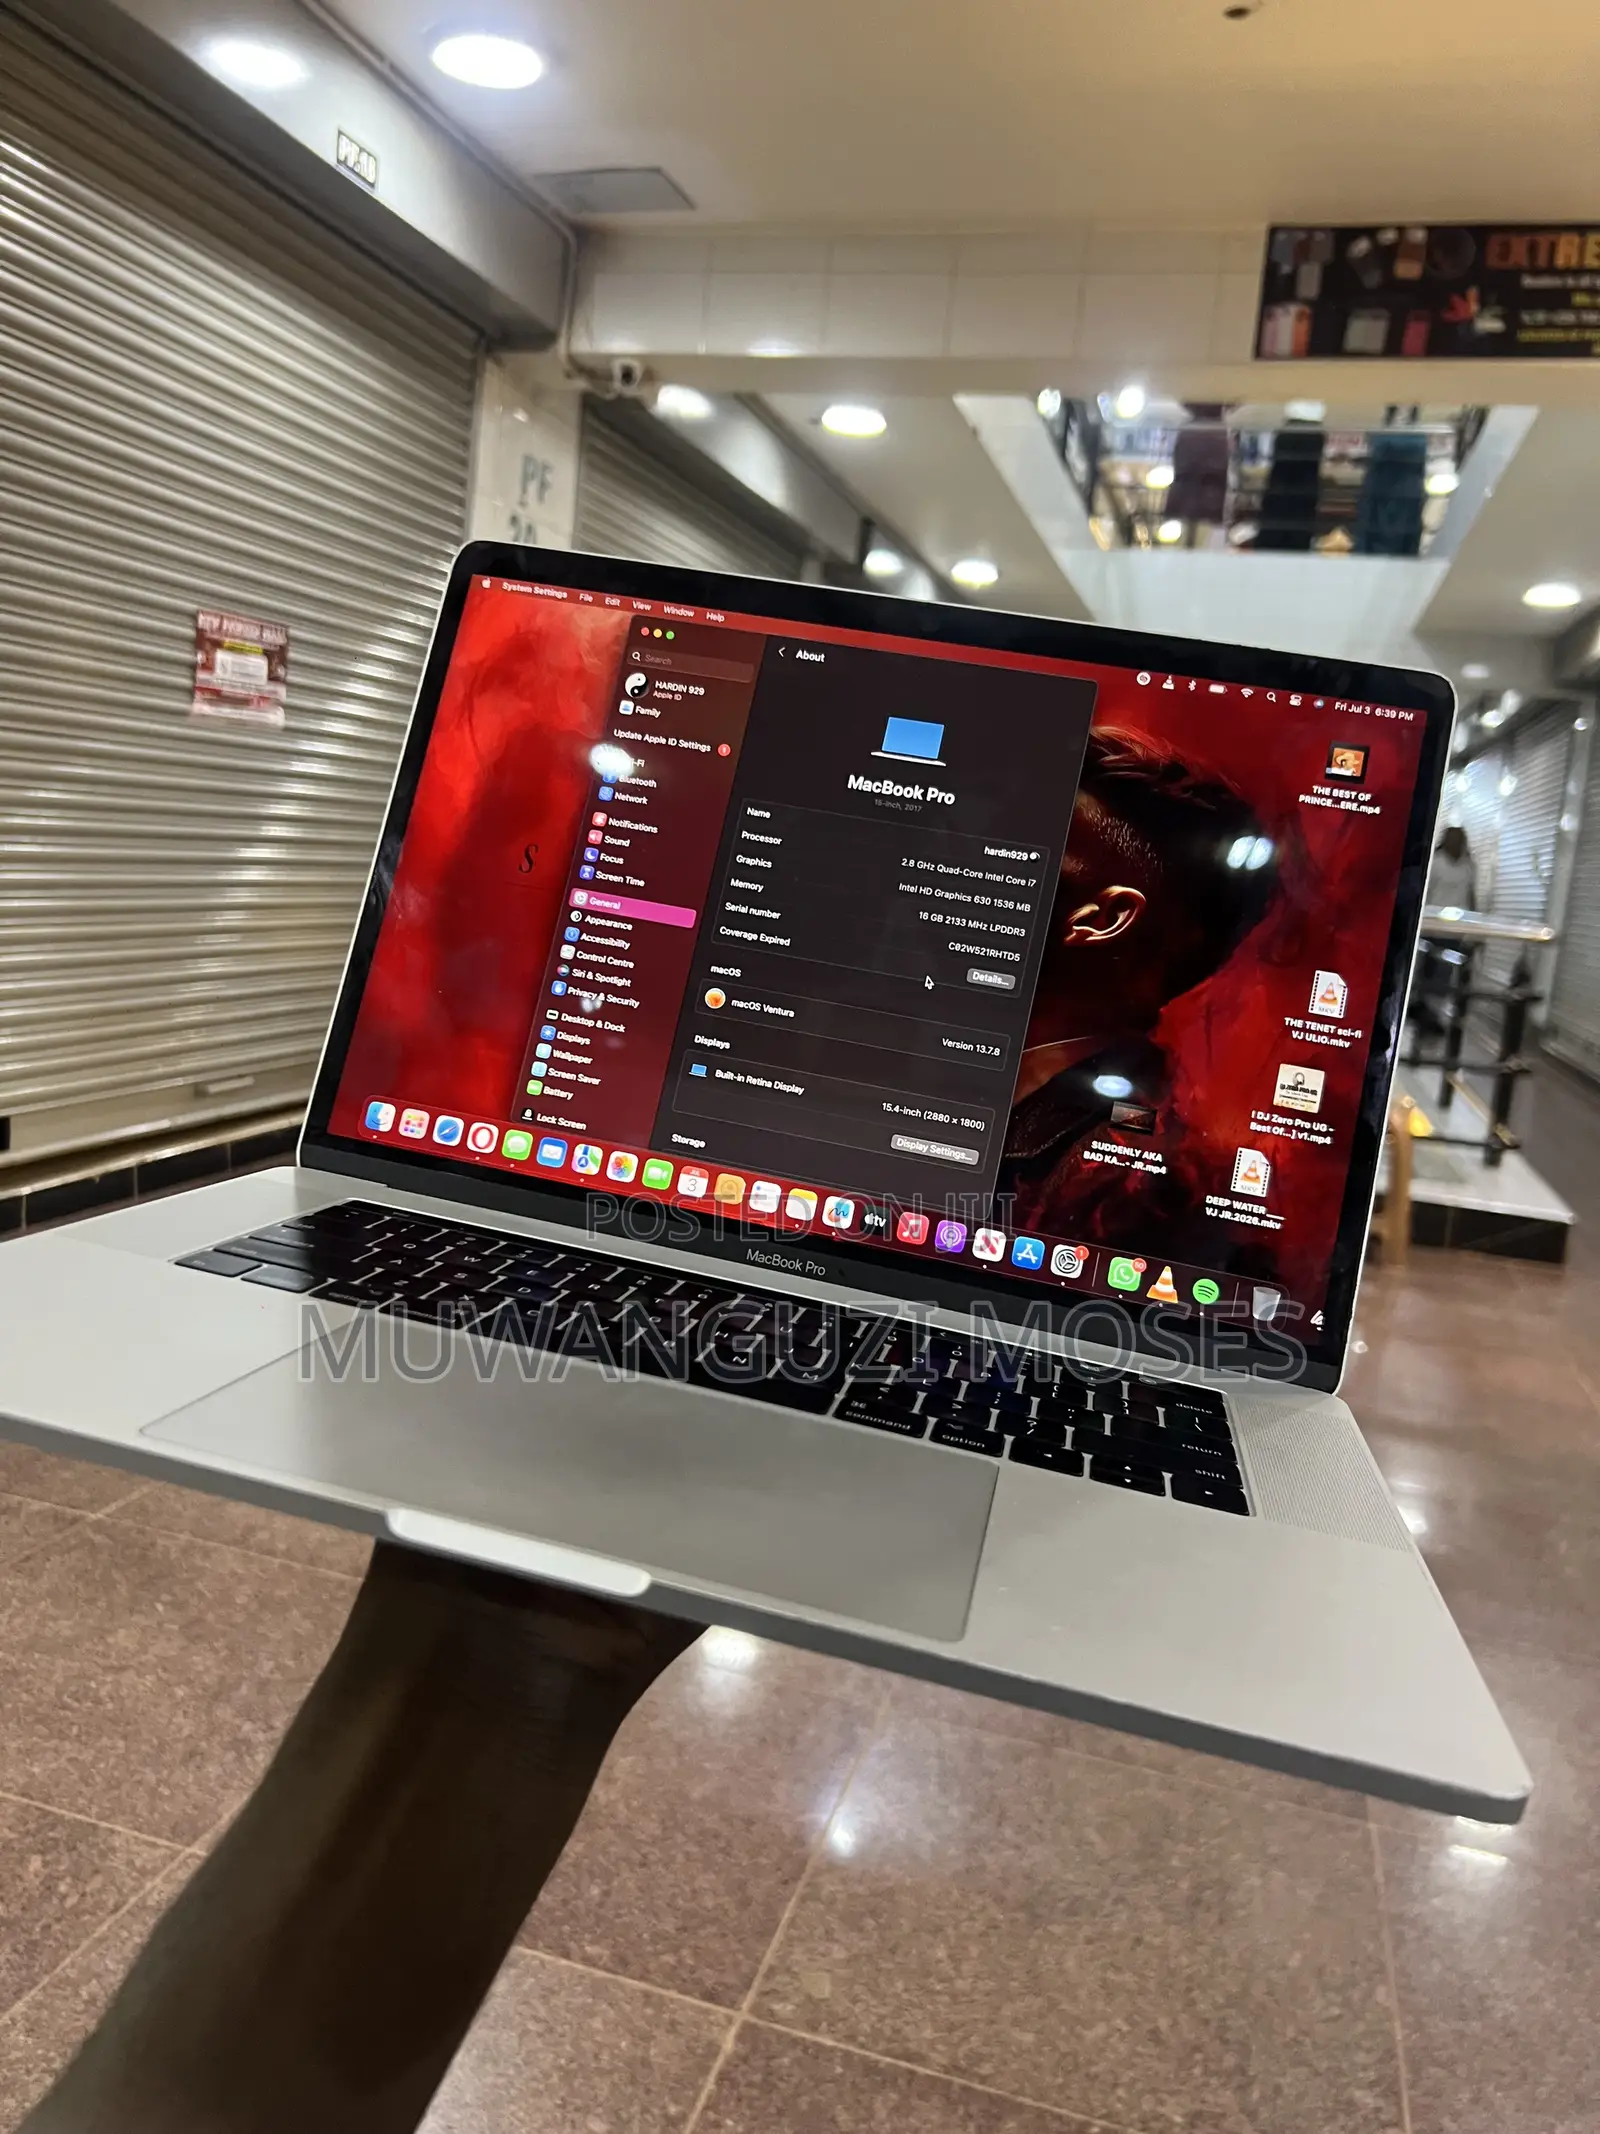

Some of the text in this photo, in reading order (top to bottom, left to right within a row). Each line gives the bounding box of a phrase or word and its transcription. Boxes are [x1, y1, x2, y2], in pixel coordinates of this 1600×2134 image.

[502, 581, 725, 623] System Settings File Edit View Window Help
[645, 654, 672, 666] Search
[796, 650, 825, 662] About
[653, 690, 682, 701] Apple ID
[655, 681, 705, 696] HARDIN 929
[635, 705, 661, 718] Family
[1335, 701, 1414, 722] Fri Jul 3 6:39 PM
[614, 729, 711, 753] Update Apple ID Settings
[619, 774, 657, 789] Bluetooth
[847, 774, 956, 805] MacBook Pro
[615, 791, 648, 805] Network
[1312, 785, 1371, 802] THE BEST OF
[747, 807, 771, 819] Name
[904, 803, 922, 812] 2017
[608, 816, 658, 833] Notifications
[604, 836, 630, 848] Sound
[742, 831, 782, 846] Processor
[600, 853, 624, 865] Focus
[736, 855, 772, 869] Graphics
[983, 846, 1028, 861] hardin929
[596, 870, 645, 888] Screen Time
[901, 857, 1037, 888] 2.8 GHz Quad-Core Intel Core i7
[730, 878, 764, 893] Memory
[589, 896, 621, 911] General
[899, 883, 1031, 912] Intel HD Graphics 630 1536 MB
[725, 902, 781, 919] Serial number
[585, 915, 633, 932] Appearance
[919, 911, 1026, 937] 16 GB 2133 MHz LPDDR3
[581, 932, 630, 950] Accessibility
[719, 926, 791, 947] Coverage Expired
[576, 950, 634, 969] Control Centre
[572, 968, 631, 987] Siri & Spotlight
[710, 965, 742, 977] macOS
[568, 986, 597, 1001] Privacy
[607, 994, 640, 1008] Security
[731, 998, 795, 1018] macOS Ventura
[561, 1012, 625, 1033] Desktop & Dock
[1284, 1017, 1303, 1029] THE
[1304, 1021, 1336, 1034] TENET
[557, 1031, 591, 1046] Displays
[694, 1035, 730, 1050] Displays
[1292, 1030, 1304, 1040] VJ
[942, 1037, 1000, 1057] Version 13.7.8
[553, 1049, 593, 1065] Wallpaper
[548, 1067, 601, 1086] Screen Saver
[715, 1069, 805, 1096] Built-in Retina Display
[543, 1086, 574, 1101] Battery
[536, 1113, 587, 1131] Lock Screen
[882, 1101, 985, 1132] 15.4-inch (2880 1800)
[1257, 1112, 1328, 1132] DJ Zero Pro UG
[672, 1133, 706, 1150] Storage
[1250, 1122, 1271, 1134] Best
[1297, 1131, 1332, 1145] v1.mp4
[896, 1138, 929, 1156] Display
[1091, 1140, 1163, 1163] SUDDENLY AKA
[1083, 1151, 1103, 1163] BAD
[1132, 1160, 1167, 1175] JR.mp4
[687, 1178, 698, 1192] 3
[1205, 1206, 1218, 1217] VJ
[1206, 1195, 1265, 1215] DEEP WATER
[746, 1248, 826, 1276] MacBook Pro
[1175, 1402, 1214, 1415] delete
[942, 1434, 986, 1449] option
[1181, 1443, 1222, 1457] return
[1194, 1468, 1226, 1481] shift
